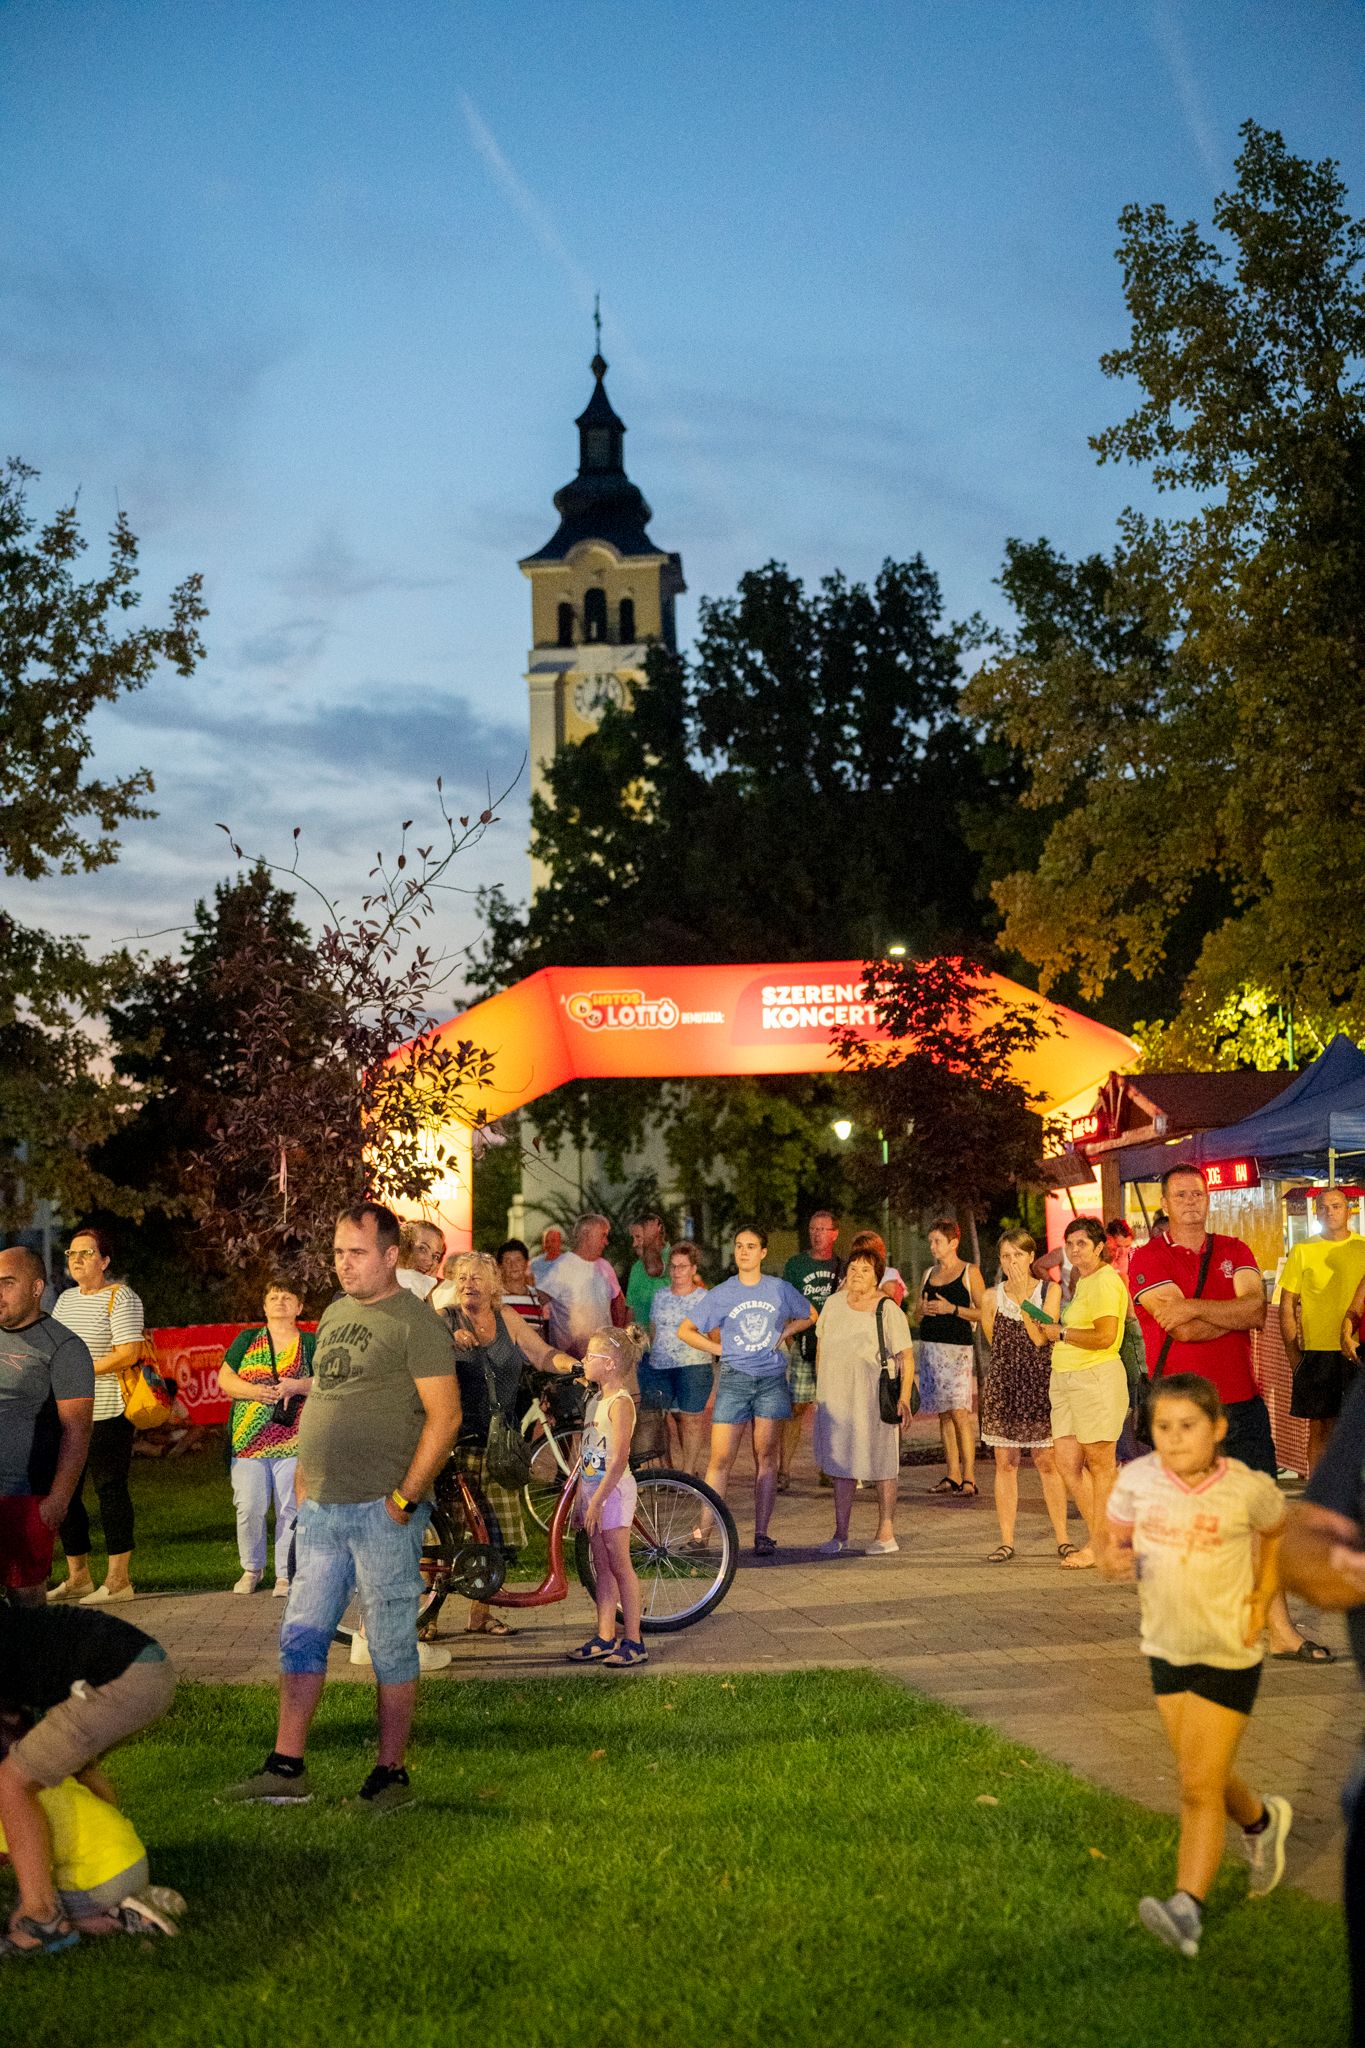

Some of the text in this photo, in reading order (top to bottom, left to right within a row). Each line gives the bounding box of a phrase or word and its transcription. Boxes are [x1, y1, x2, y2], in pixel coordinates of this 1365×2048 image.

[762, 982, 899, 1006] SZERENC
[762, 1005, 888, 1029] KONCERT
[803, 1283, 832, 1296] Brook
[729, 1300, 776, 1319] UNIVERSITY
[733, 1335, 745, 1346] OF
